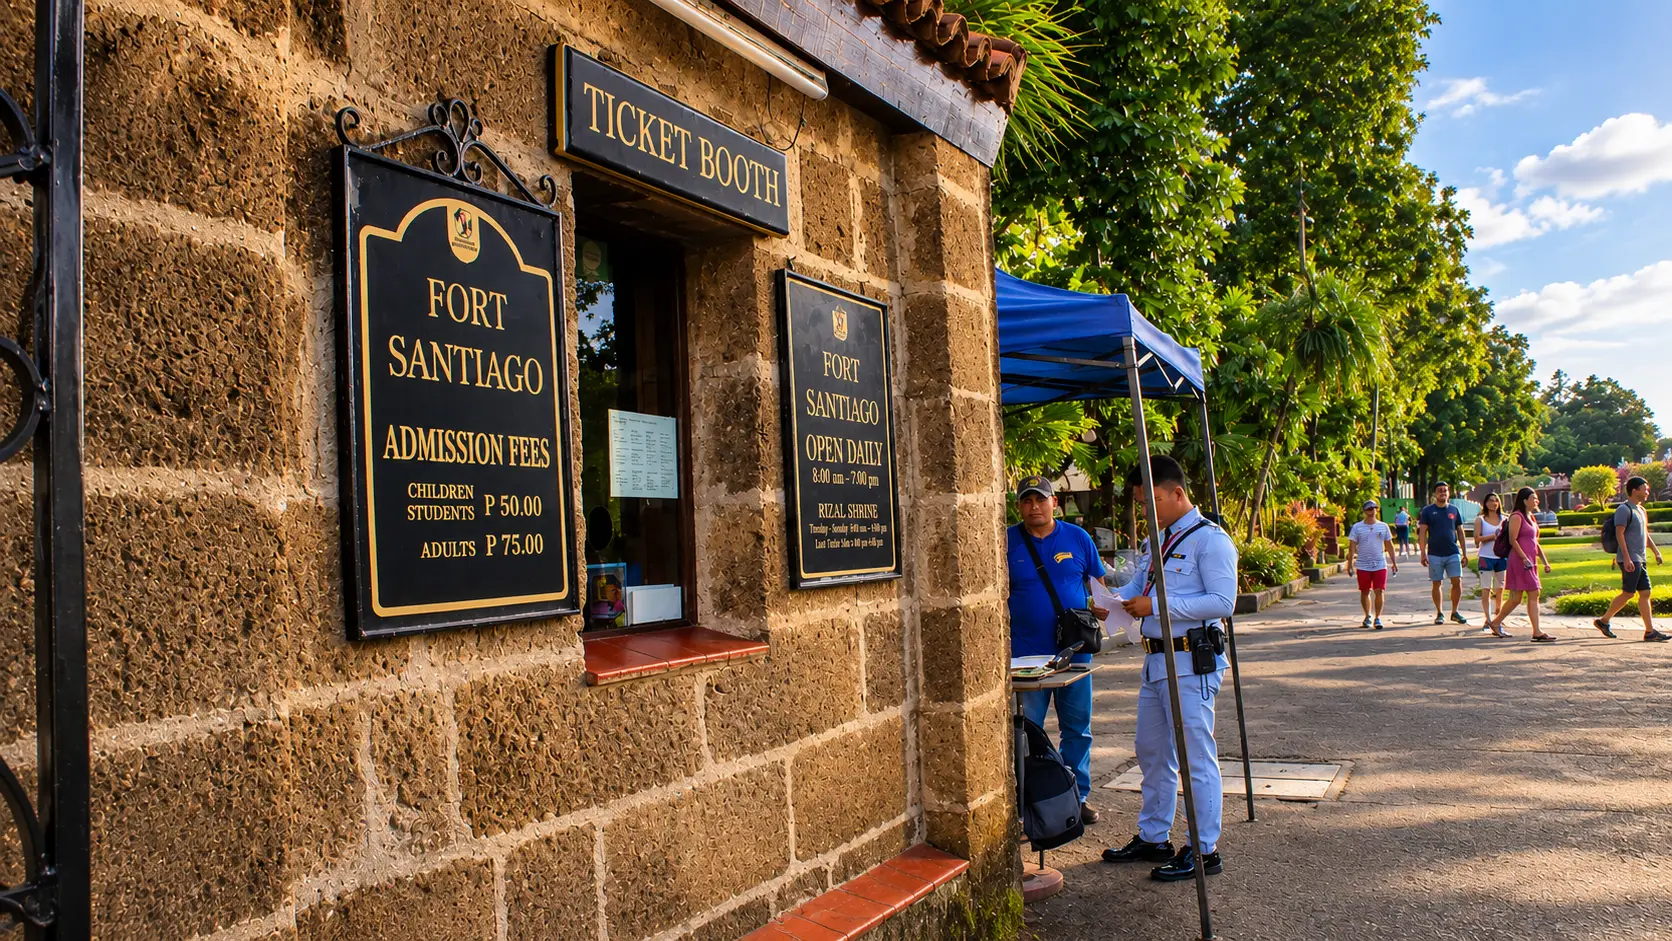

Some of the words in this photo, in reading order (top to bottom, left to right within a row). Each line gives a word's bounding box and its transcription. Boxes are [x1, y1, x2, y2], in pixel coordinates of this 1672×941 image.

[583, 82, 692, 171] TICKET
[698, 136, 781, 207] BOOTH
[427, 278, 507, 330] FORT
[389, 335, 542, 394] SANTIAGO
[823, 351, 859, 383] FORT
[807, 389, 878, 425] SANTIAGO
[383, 425, 503, 465] ADMISSION
[508, 436, 550, 468] FEES
[806, 434, 842, 462] OPEN
[847, 439, 882, 466] DAILY
[408, 483, 473, 499] CHILDREN
[813, 467, 830, 483] 8:00
[833, 474, 844, 484] am
[869, 476, 879, 489] pm
[408, 505, 474, 520] STUDENTS
[484, 495, 495, 515] P
[501, 495, 541, 516] 50.00
[819, 503, 846, 518] RIZAL
[848, 504, 877, 518] SHRINE
[421, 541, 475, 558] ADULTS
[486, 535, 496, 556] P
[502, 534, 543, 555] 75.00
